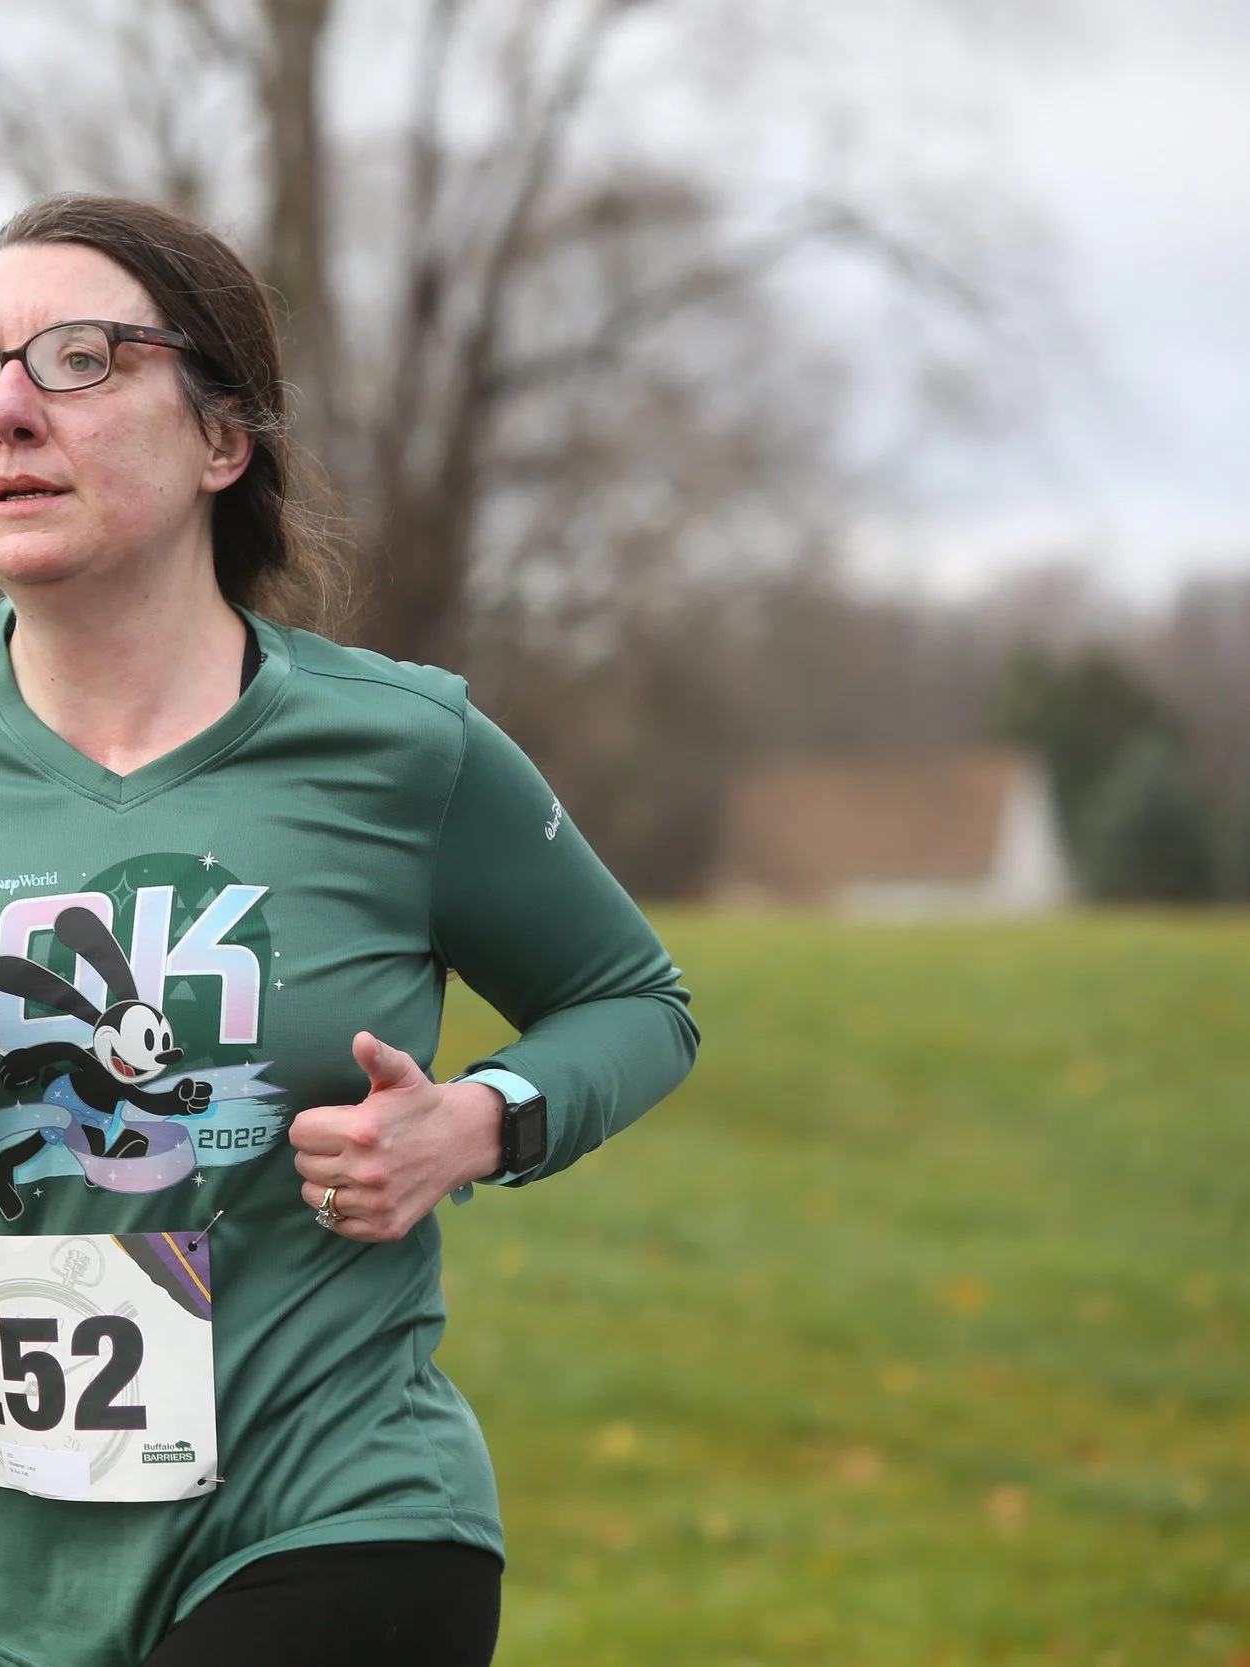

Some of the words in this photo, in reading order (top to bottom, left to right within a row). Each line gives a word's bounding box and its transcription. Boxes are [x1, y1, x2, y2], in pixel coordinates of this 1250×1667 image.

[198, 1126, 267, 1149] 2022
[143, 1443, 176, 1451] Buffalo
[143, 1453, 193, 1462] BARRIERS
